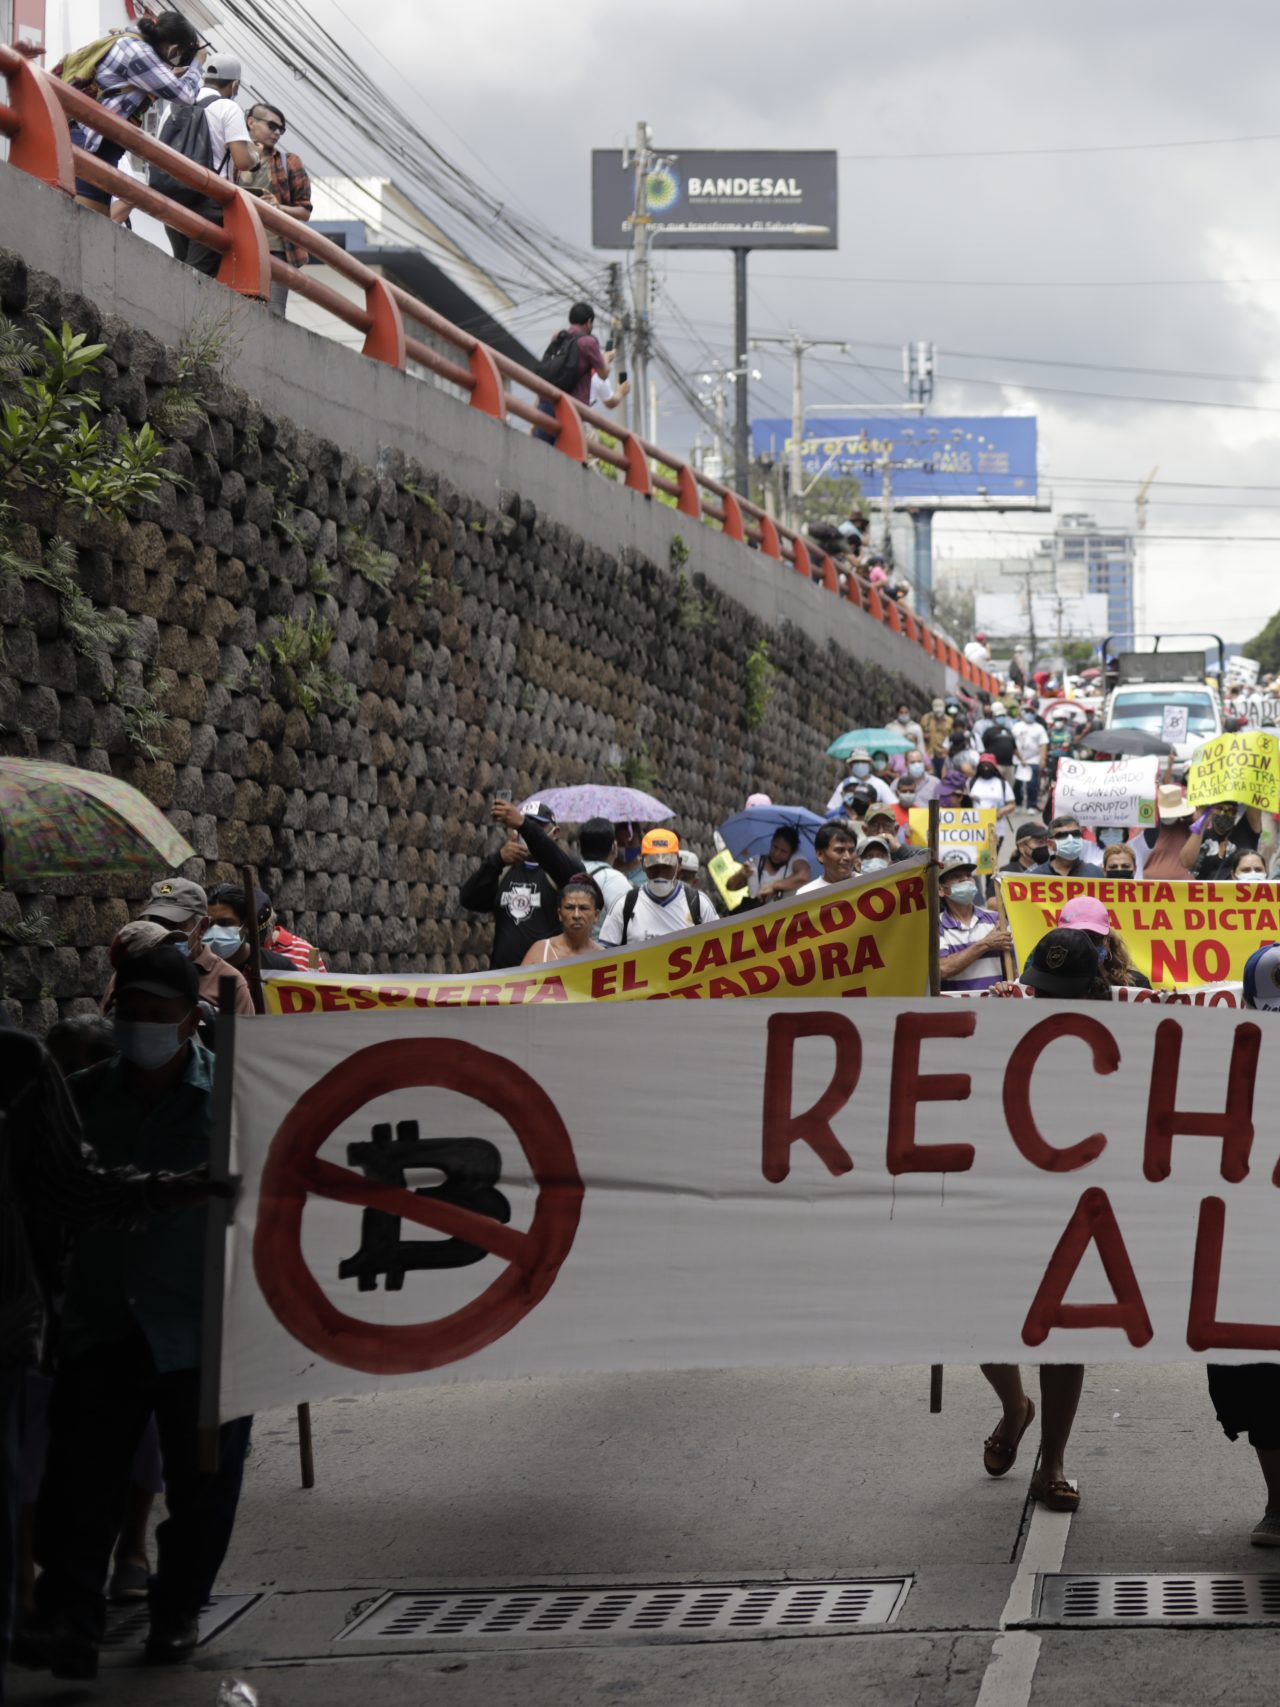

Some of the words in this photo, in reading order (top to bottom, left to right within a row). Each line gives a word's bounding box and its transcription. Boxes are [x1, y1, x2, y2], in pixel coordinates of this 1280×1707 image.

[688, 177, 803, 197] BANDESAL
[1202, 743, 1224, 760] NO
[1230, 738, 1252, 751] AL
[1197, 752, 1271, 778] BITCOIN
[1062, 785, 1076, 797] DE
[1251, 793, 1270, 808] NO
[939, 811, 955, 824] O
[961, 811, 979, 824] AL
[940, 829, 986, 842] TCOIN
[1008, 881, 1176, 903] DESPIERTA
[1188, 882, 1224, 903] EL
[1133, 909, 1173, 931] LA
[276, 975, 570, 1015] DESPIERTA
[591, 959, 649, 999] EL
[667, 876, 928, 981] SALVADOR
[1150, 939, 1231, 983] NO
